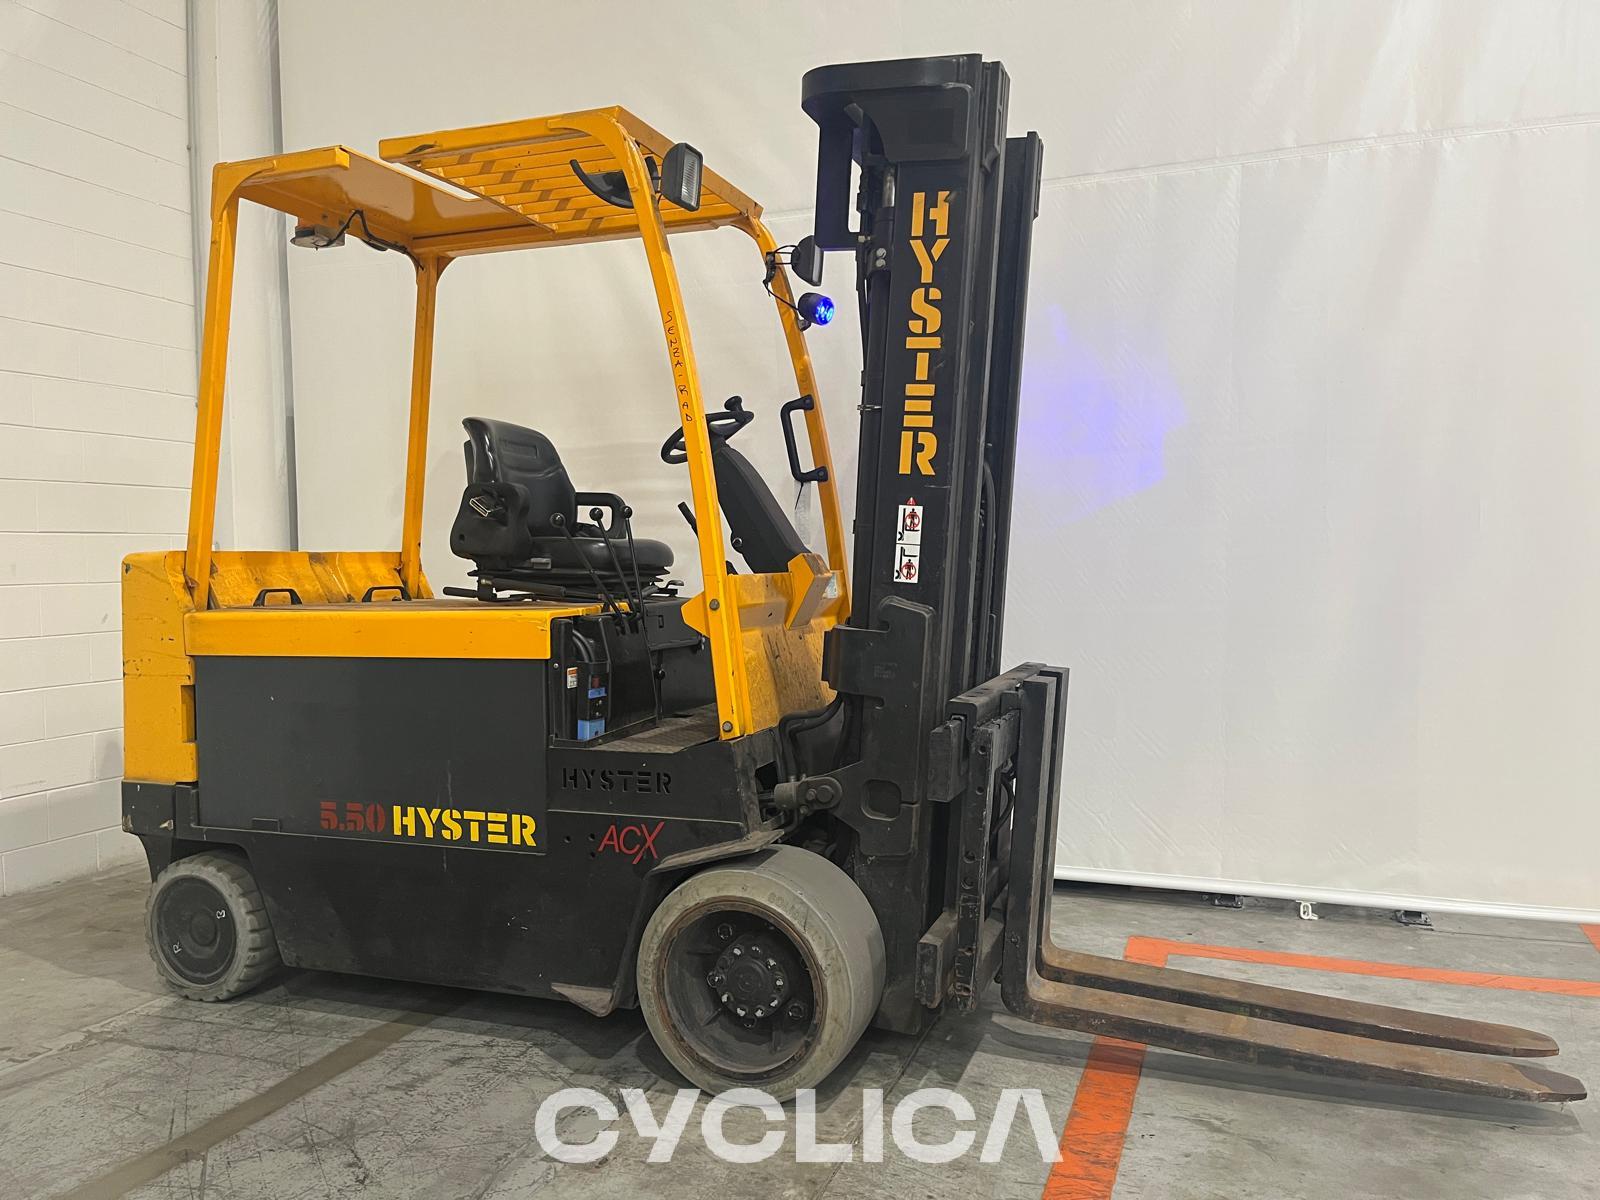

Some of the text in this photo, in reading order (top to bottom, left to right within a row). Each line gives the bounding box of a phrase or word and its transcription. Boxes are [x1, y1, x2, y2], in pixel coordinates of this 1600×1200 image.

[899, 191, 950, 476] HYSTER
[562, 767, 672, 795] HYSTER
[320, 801, 537, 847] 5.50 HYSTER
[597, 821, 665, 865] ACX
